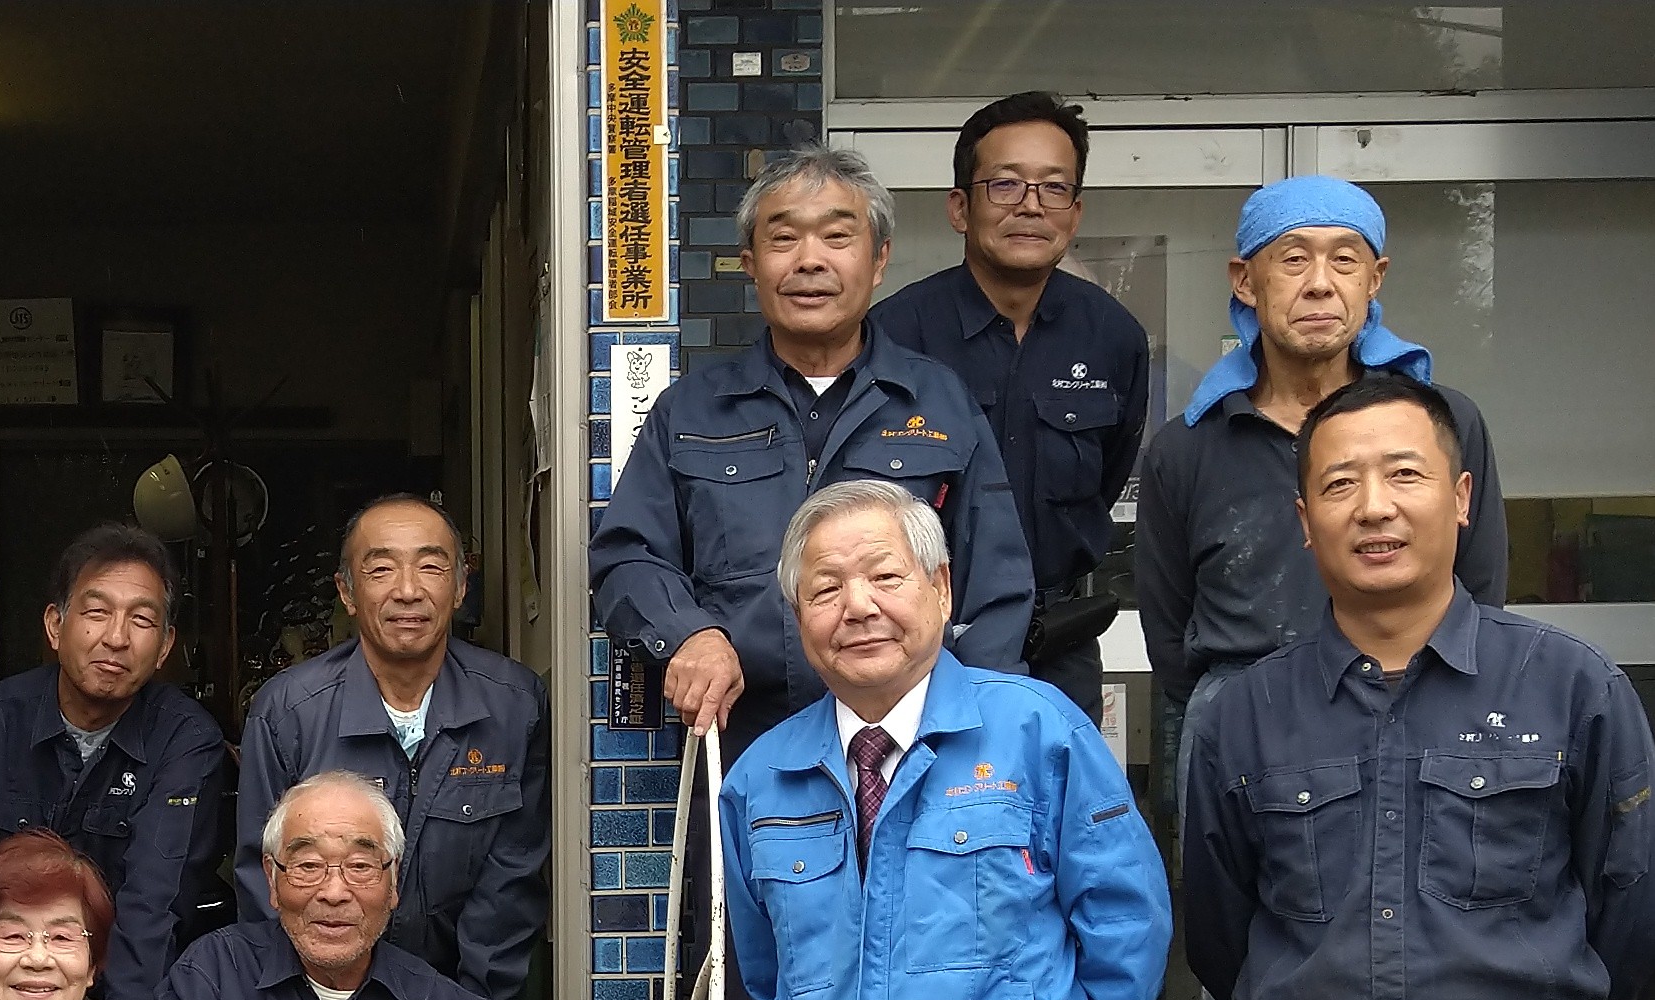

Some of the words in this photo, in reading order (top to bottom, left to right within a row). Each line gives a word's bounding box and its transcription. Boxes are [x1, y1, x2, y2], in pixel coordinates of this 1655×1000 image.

[618, 47, 653, 310] 安全運転管理者選任事業所
